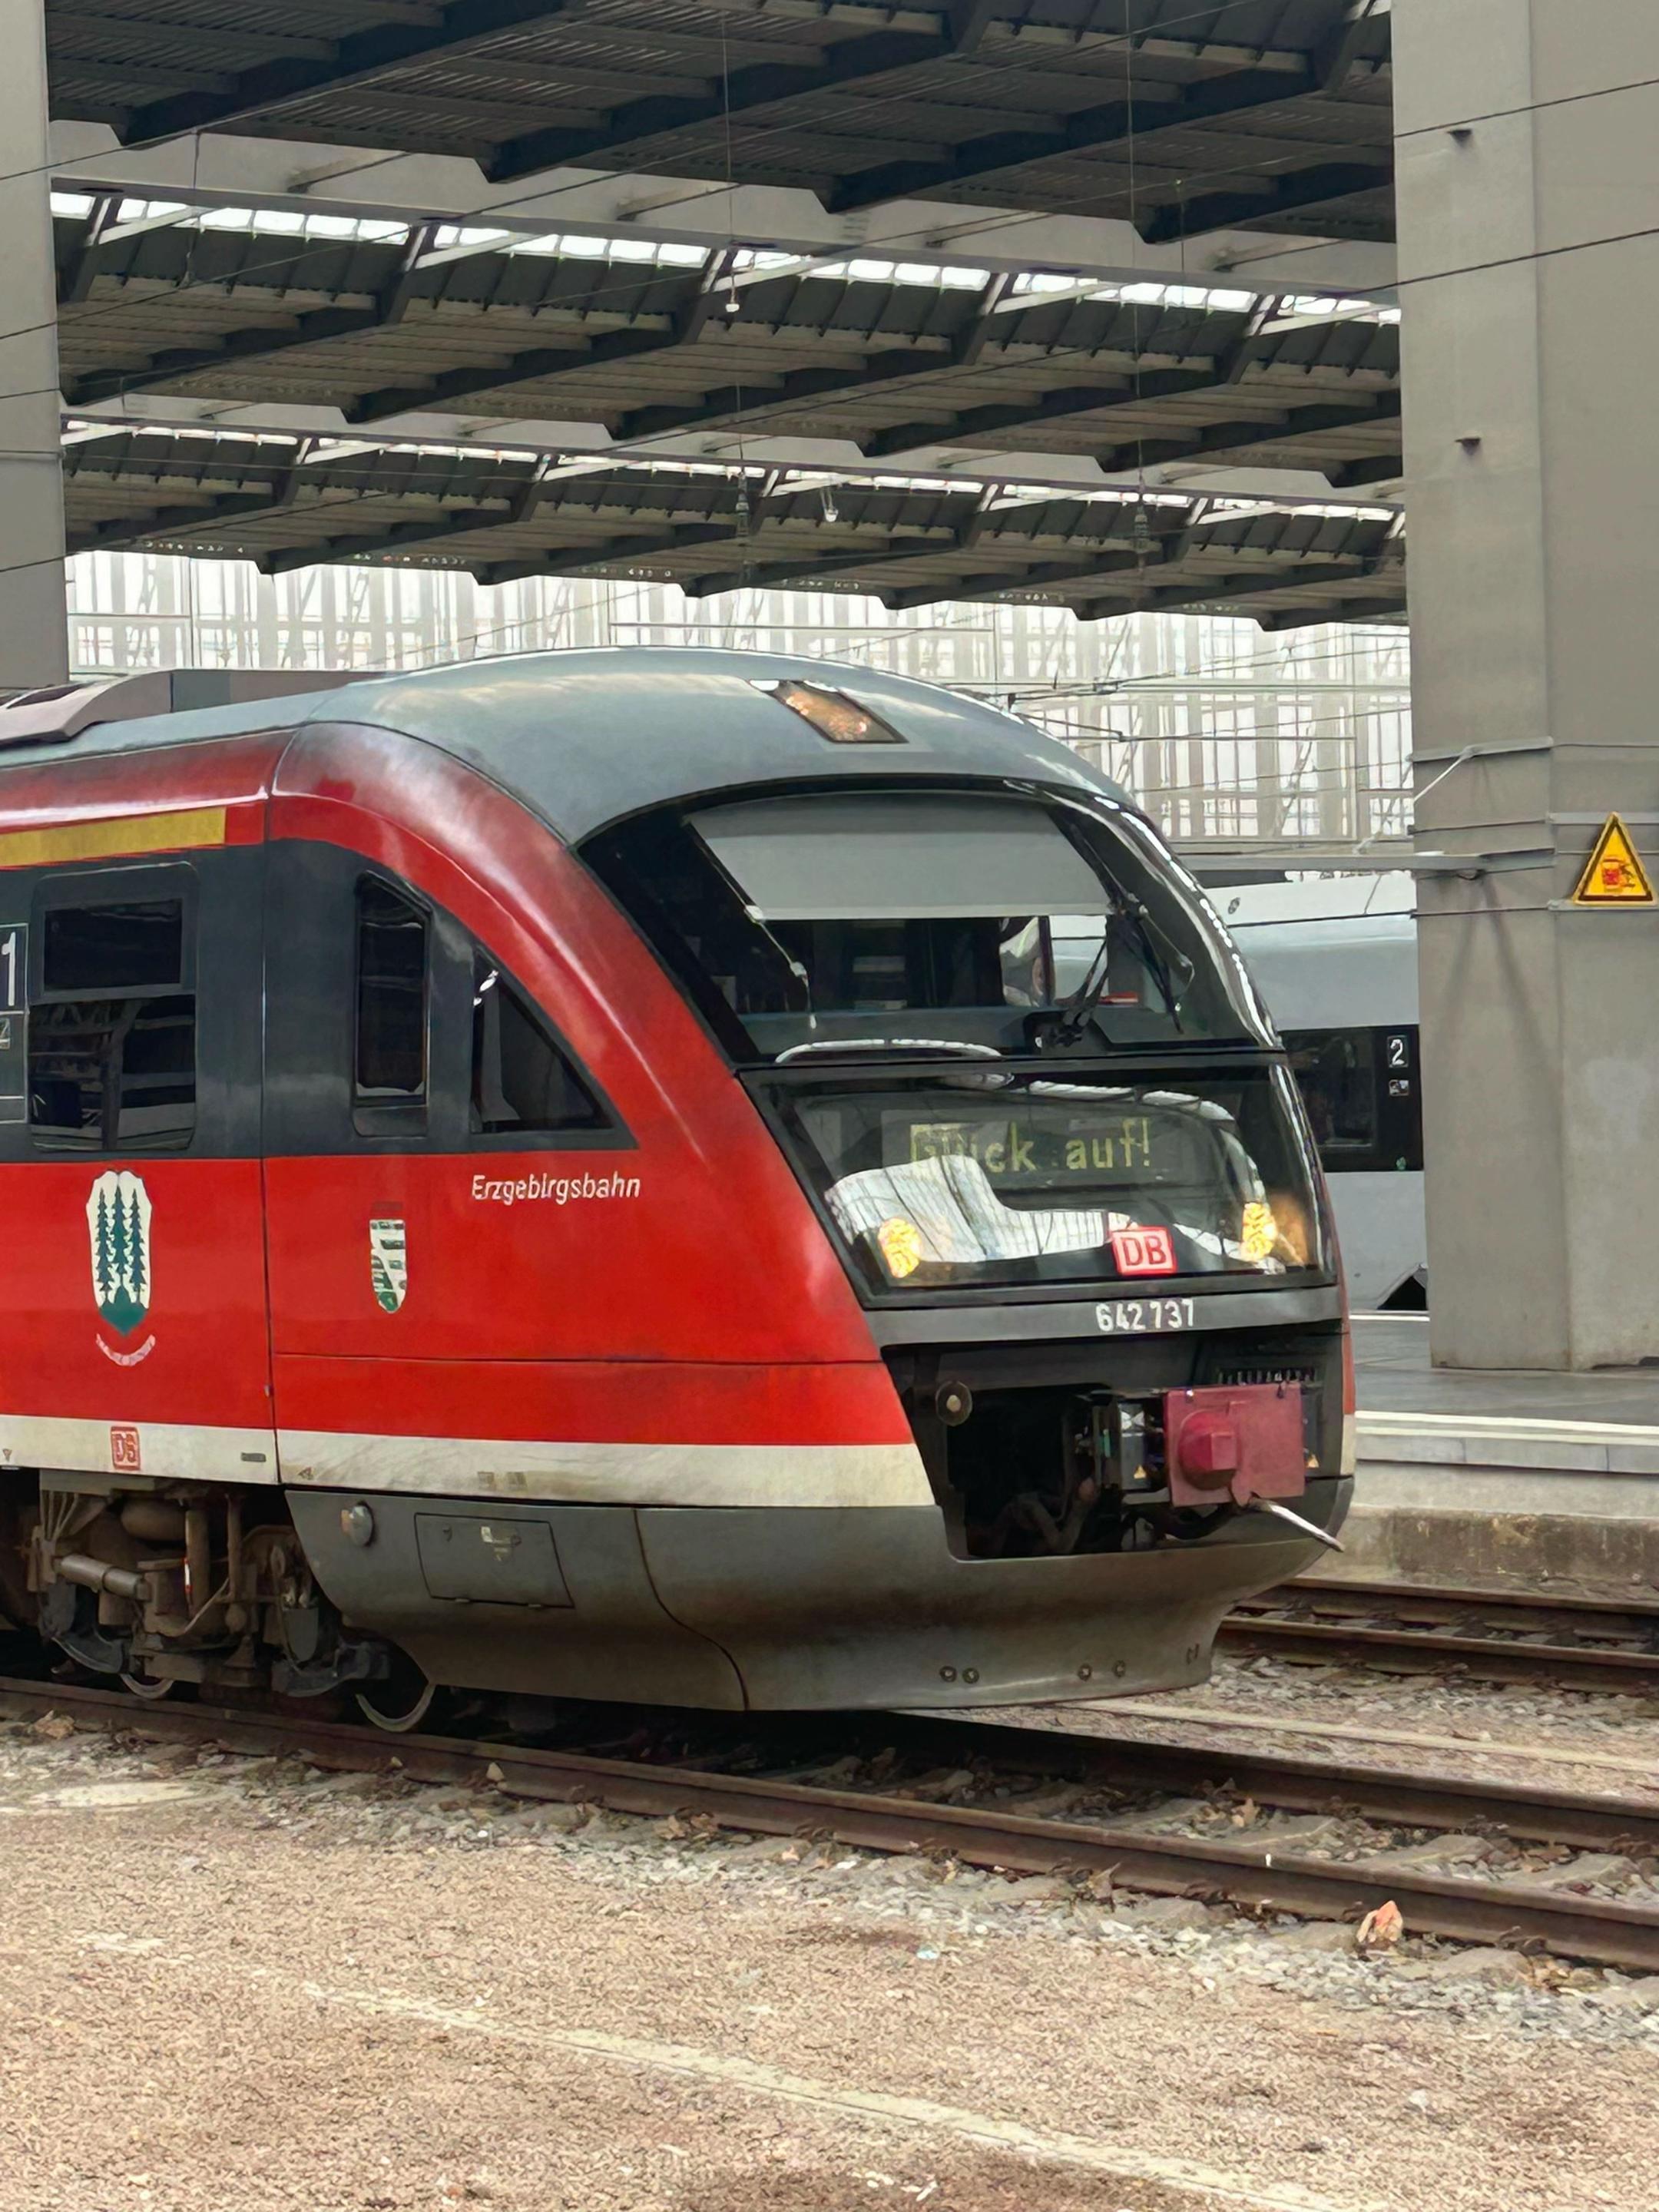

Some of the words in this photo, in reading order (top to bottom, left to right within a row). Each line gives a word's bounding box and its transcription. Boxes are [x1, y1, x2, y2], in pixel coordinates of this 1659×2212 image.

[2, 931, 16, 1007] 1
[1390, 1038, 1405, 1066] 2
[1065, 1117, 1151, 1170] auf!
[472, 1171, 641, 1206] Erzgebirgsbahn
[1119, 1233, 1167, 1267] DB
[1095, 1302, 1146, 1332] 642
